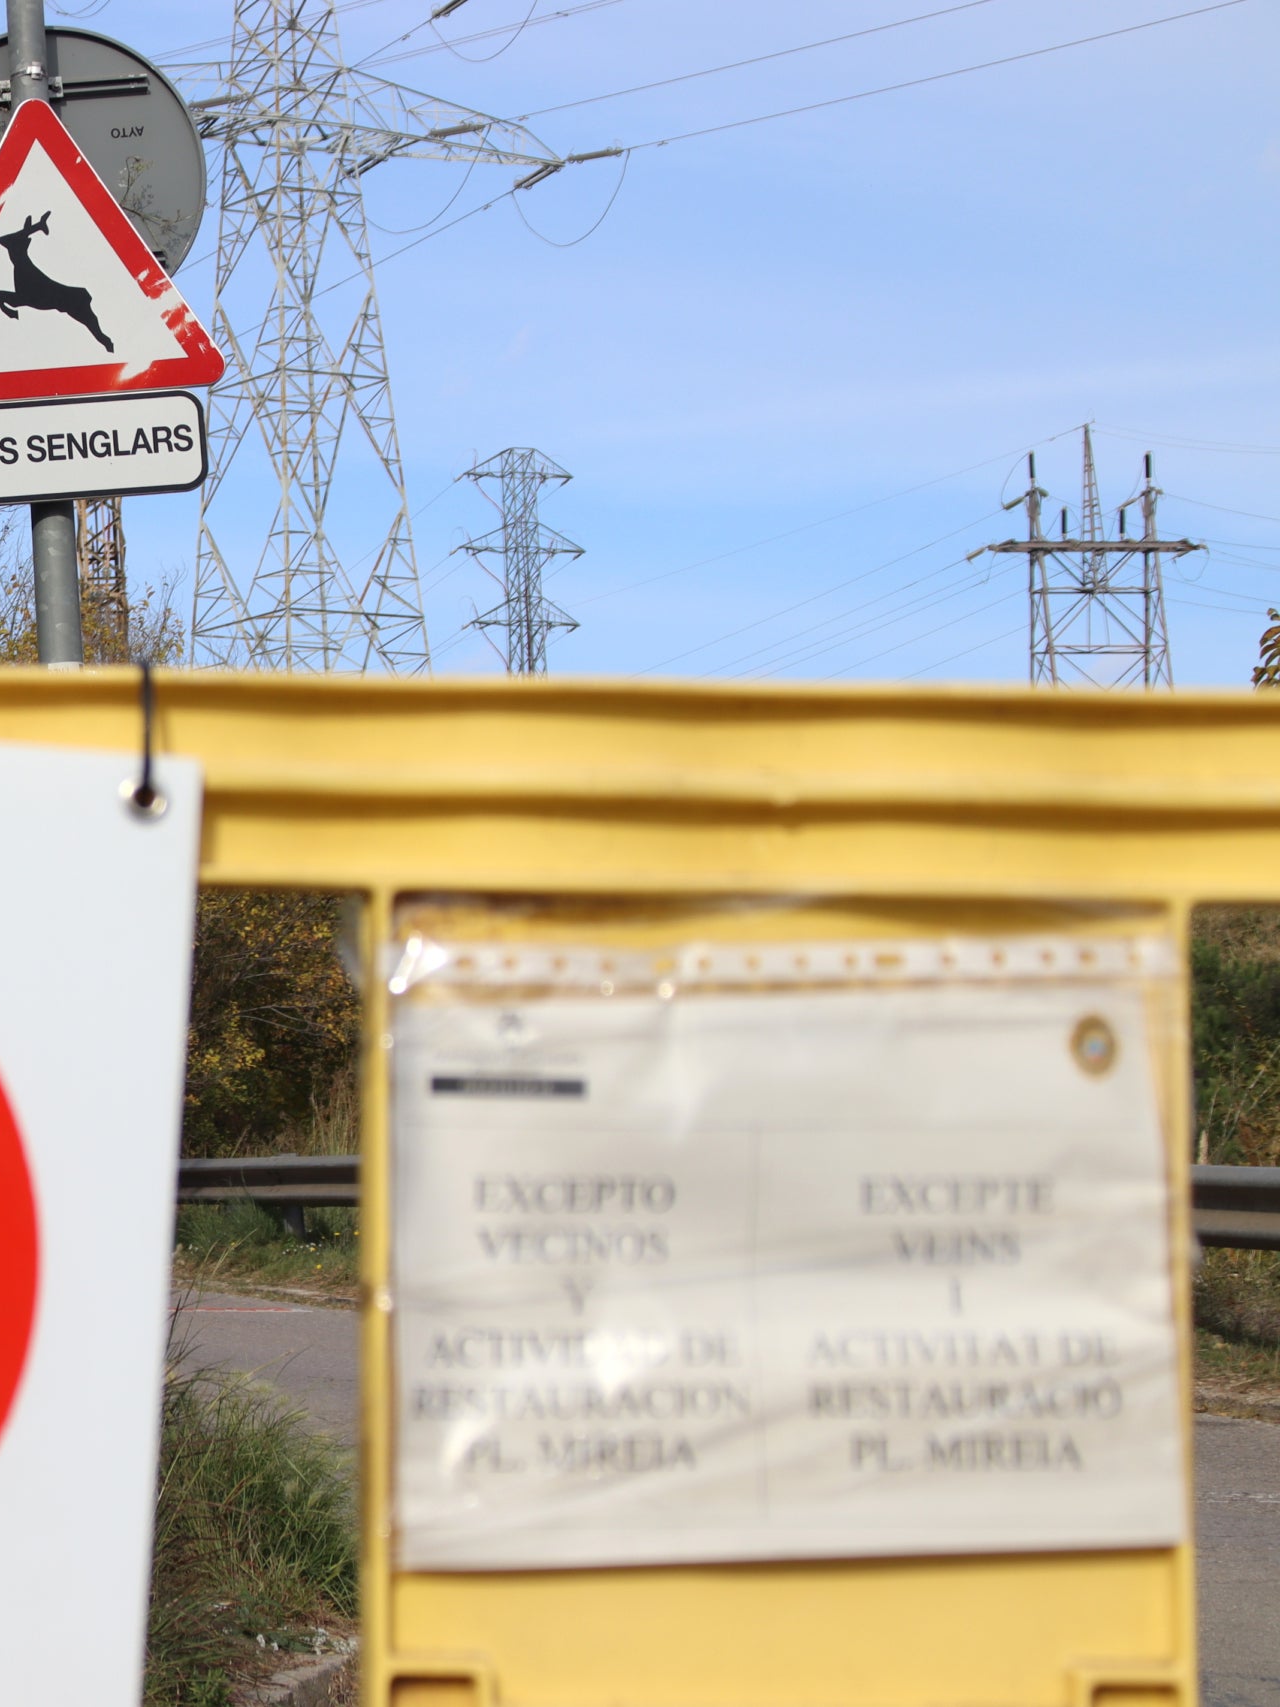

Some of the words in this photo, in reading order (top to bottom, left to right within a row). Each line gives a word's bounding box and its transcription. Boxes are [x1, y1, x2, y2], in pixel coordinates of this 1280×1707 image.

[110, 125, 144, 139] AYTO
[26, 423, 194, 462] SENGLARS
[474, 1174, 677, 1214] EXCEPTO
[858, 1173, 1055, 1215] EXCEPTE
[477, 1223, 670, 1265] VECINOS
[806, 1327, 1042, 1368] ACTIVITAT
[925, 1428, 1086, 1472] MIREIA
